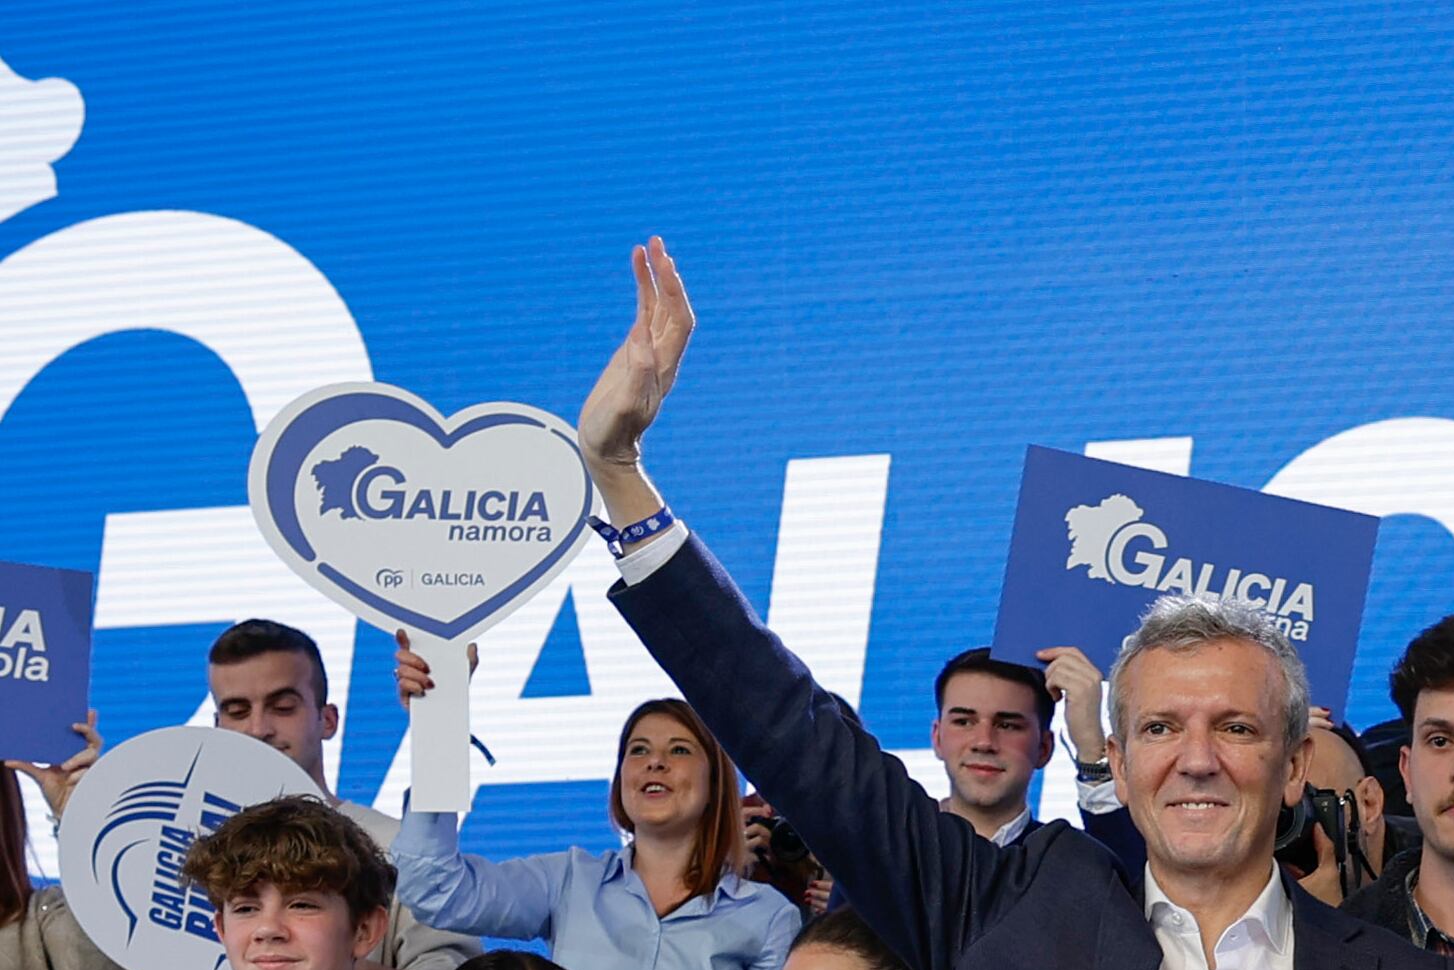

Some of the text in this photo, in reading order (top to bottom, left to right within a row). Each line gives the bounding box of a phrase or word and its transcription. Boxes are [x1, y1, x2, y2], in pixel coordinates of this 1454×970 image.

[356, 466, 550, 522] GALICIA
[448, 525, 552, 542] namora
[421, 573, 486, 587] GALICIA
[1107, 522, 1314, 622] GALICIA
[149, 825, 195, 931] GALICIA
